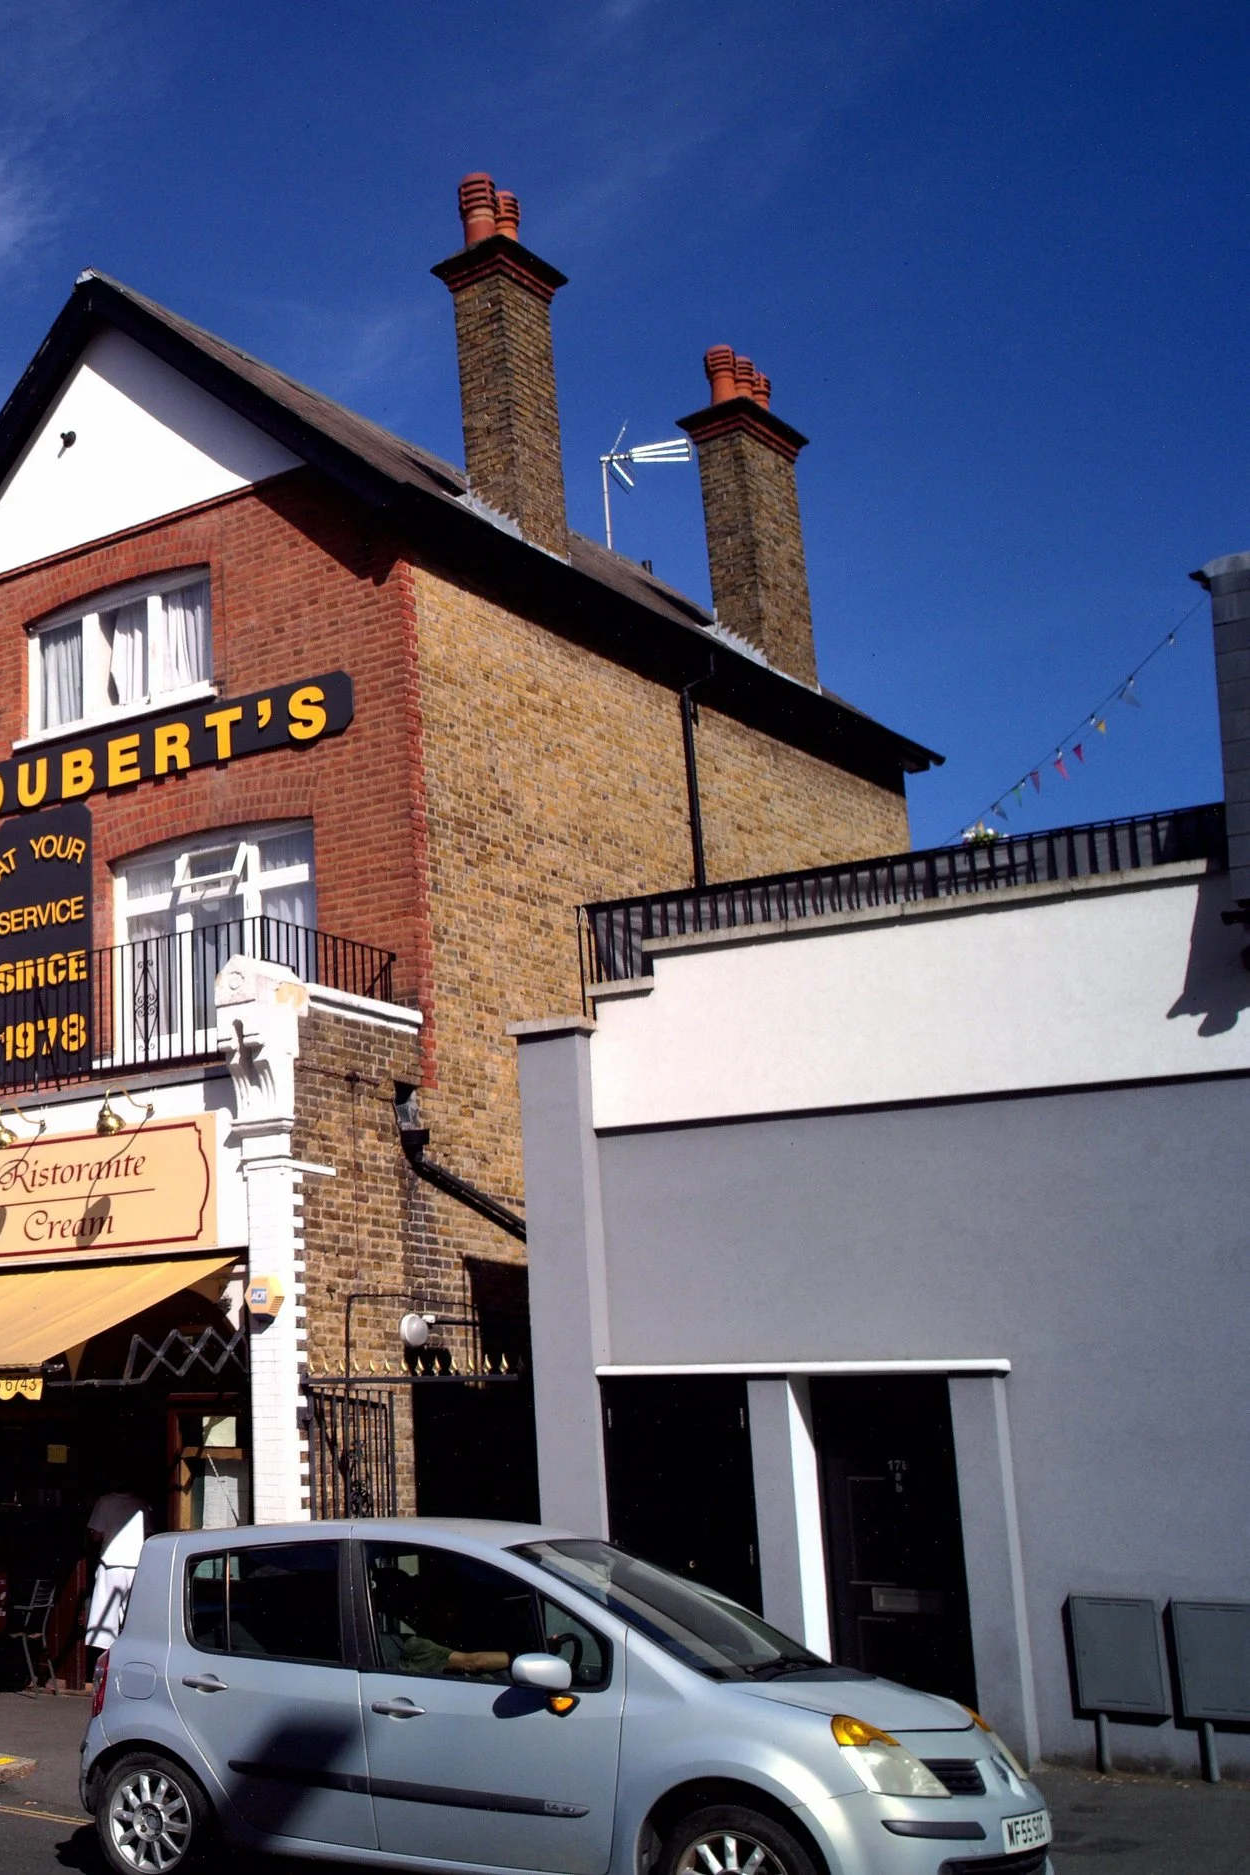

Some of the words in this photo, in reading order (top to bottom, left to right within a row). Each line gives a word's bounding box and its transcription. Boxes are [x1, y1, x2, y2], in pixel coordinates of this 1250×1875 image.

[29, 835, 86, 864] YOUR
[0, 1013, 87, 1062] 1978
[23, 1209, 116, 1241] Cream
[251, 1289, 267, 1301] ADT
[5, 1377, 37, 1392] 6743
